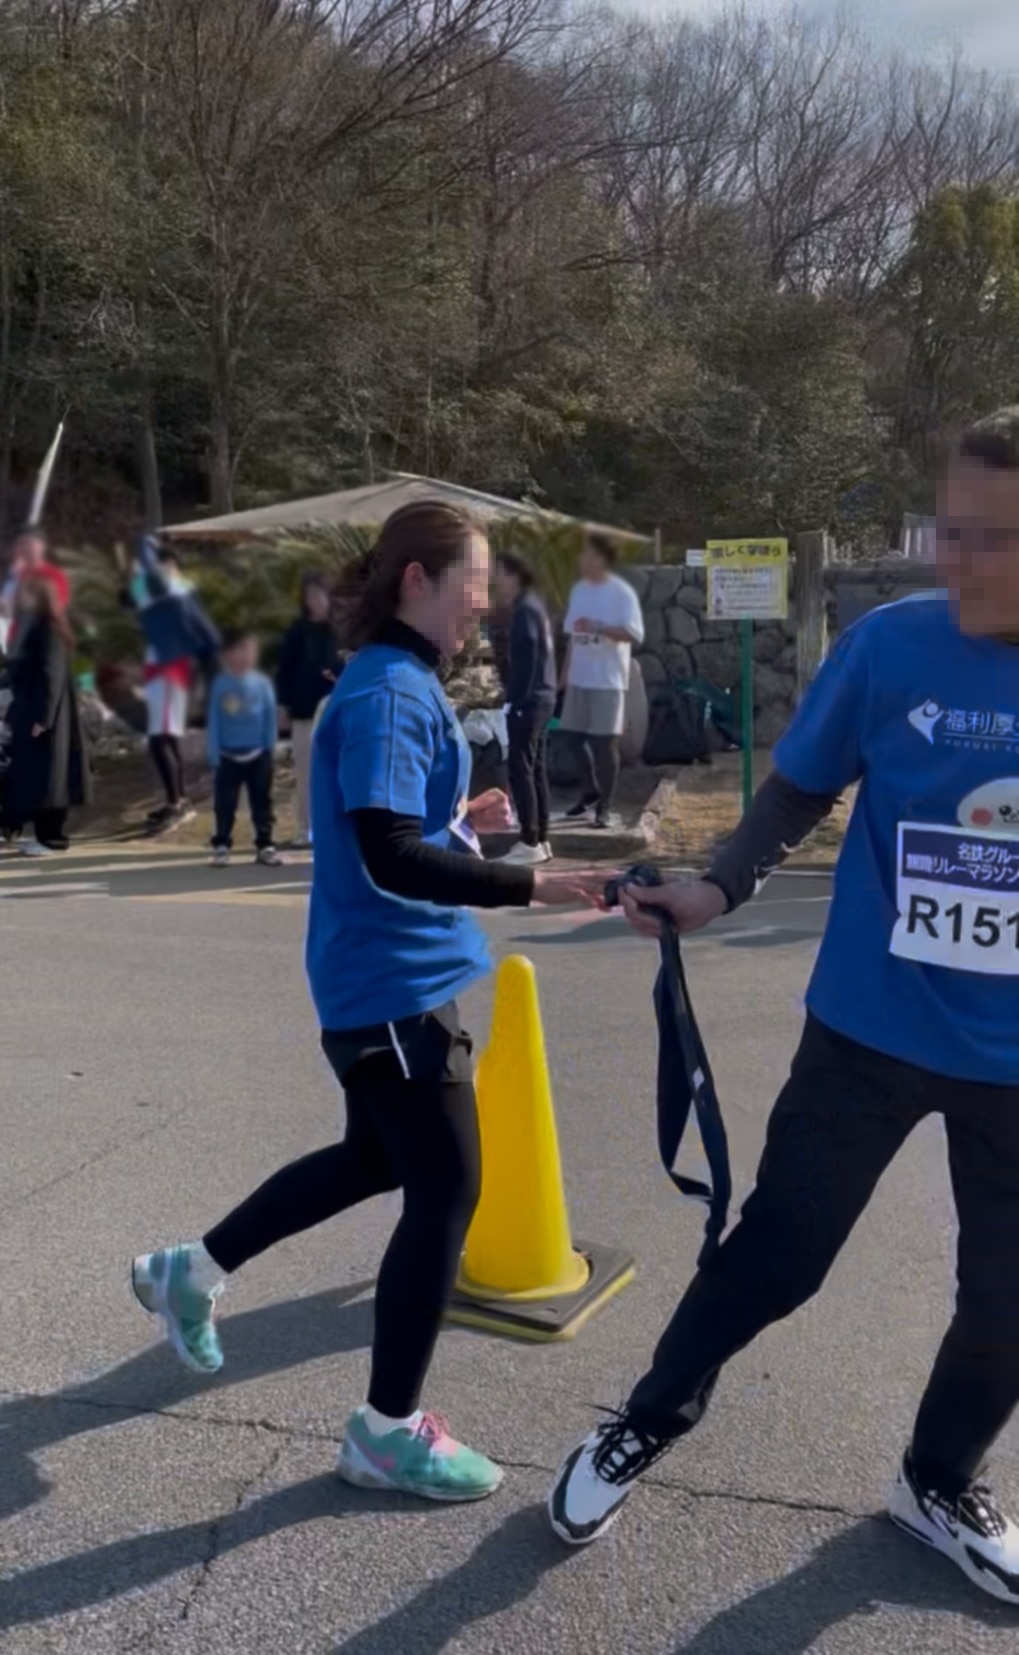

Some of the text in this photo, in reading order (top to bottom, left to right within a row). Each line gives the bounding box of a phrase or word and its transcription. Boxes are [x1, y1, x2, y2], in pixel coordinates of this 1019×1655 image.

[945, 710, 1019, 735] 福利厚
[958, 842, 1019, 863] 名鉄グルー
[906, 854, 1019, 883] リレーマラソン
[907, 894, 1019, 950] R151
